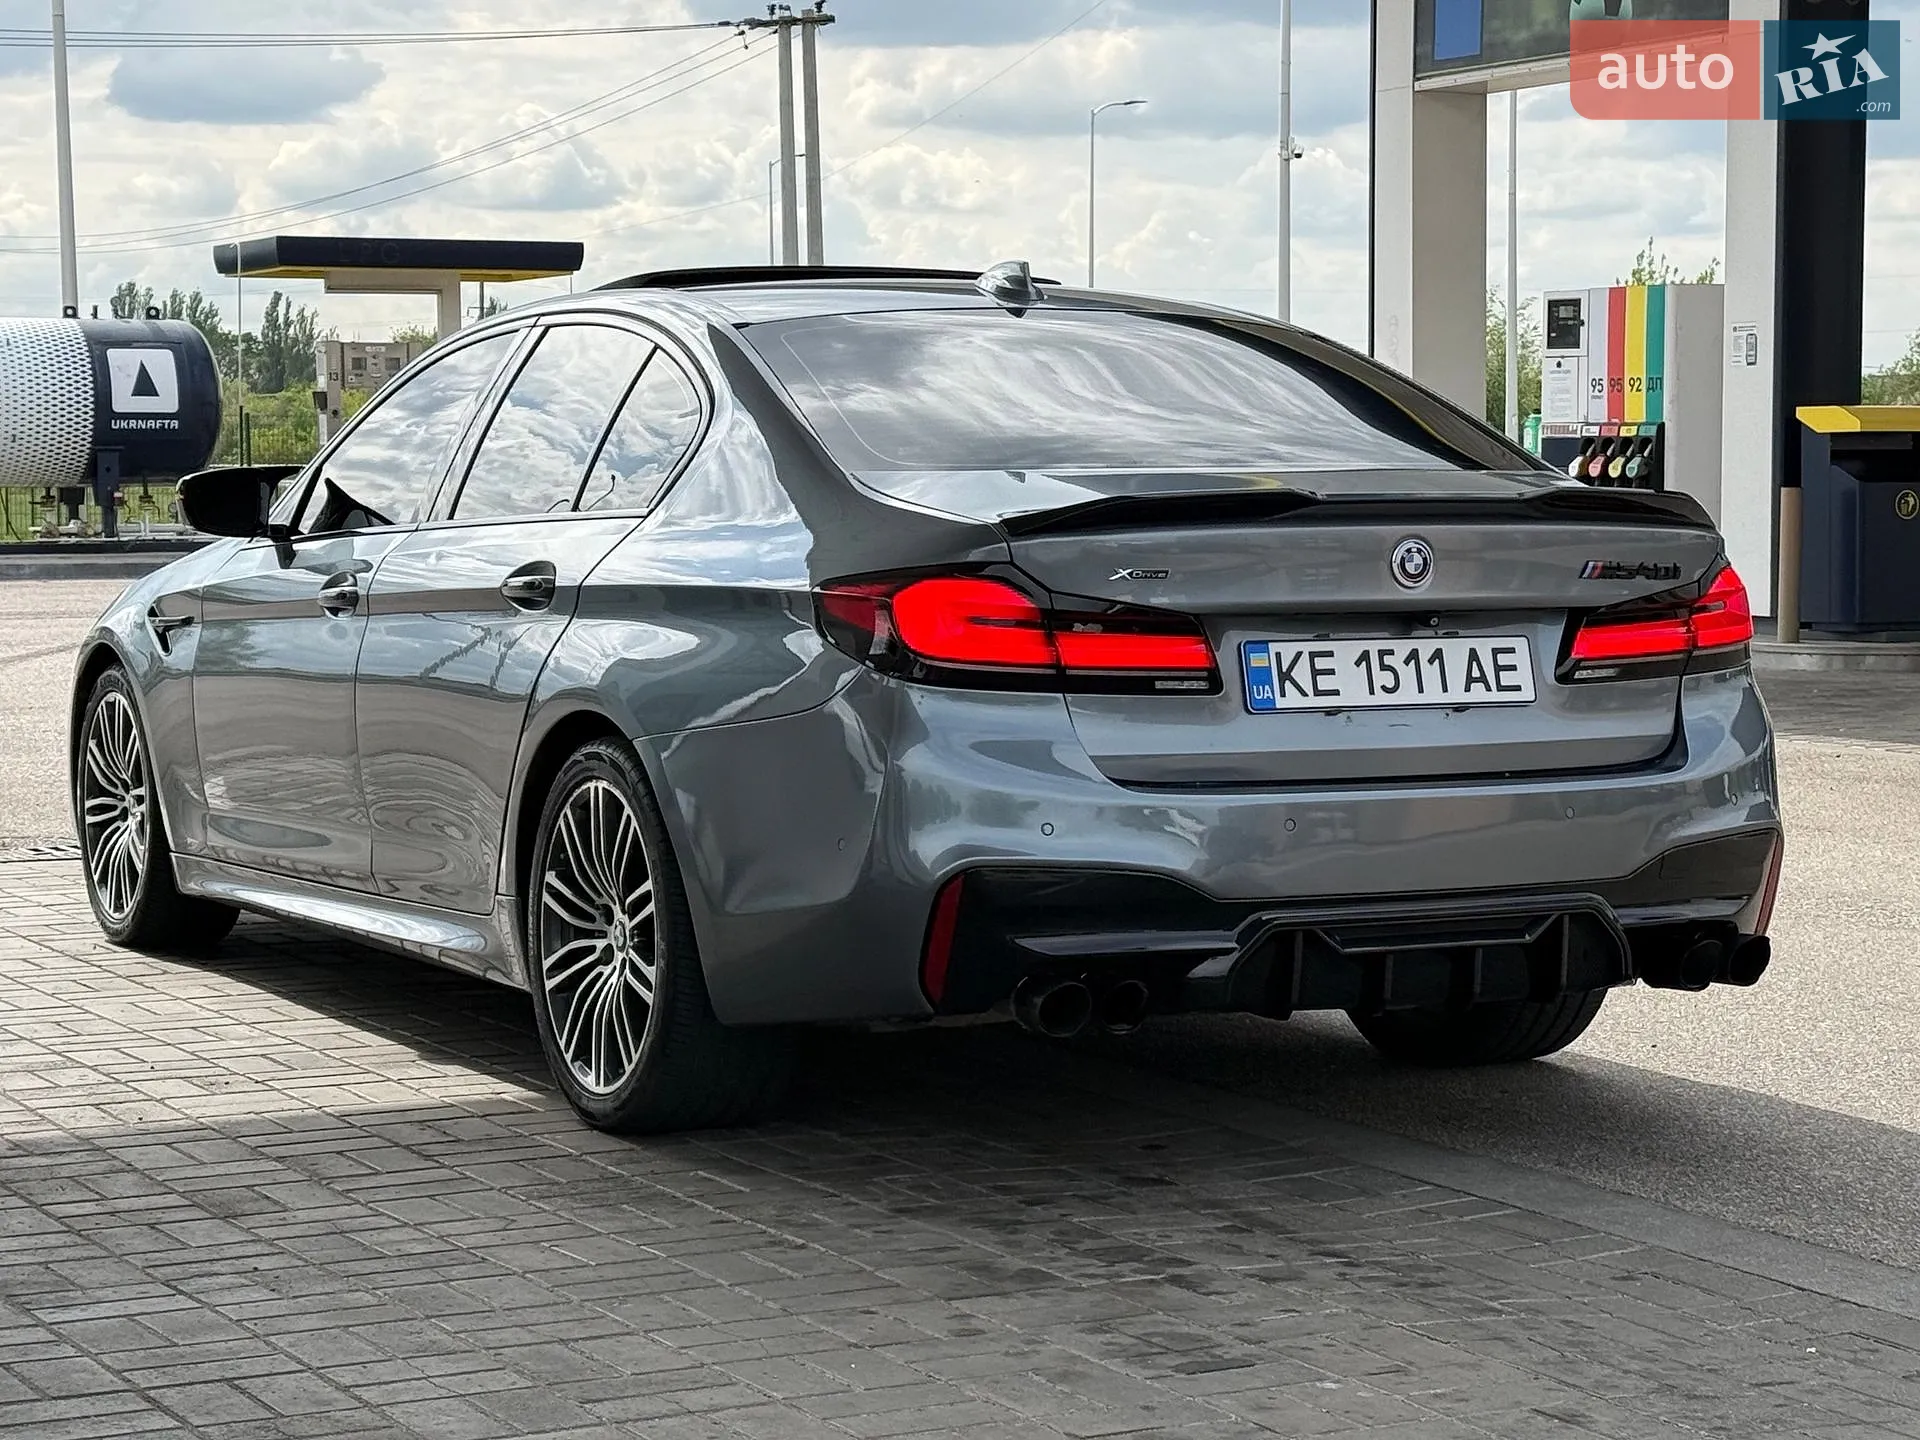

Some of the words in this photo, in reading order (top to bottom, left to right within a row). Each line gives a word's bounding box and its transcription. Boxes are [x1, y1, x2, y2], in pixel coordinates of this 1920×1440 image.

[328, 371, 339, 381] 13
[1590, 378, 1604, 393] 95
[1609, 378, 1623, 393] 95
[1628, 376, 1642, 392] 92
[1646, 376, 1662, 393] ДП
[111, 419, 179, 430] UKRNAFTA
[1274, 650, 1341, 698] KE
[1354, 647, 1449, 696] 1511
[1464, 647, 1523, 693] AE
[1253, 684, 1274, 700] UA
